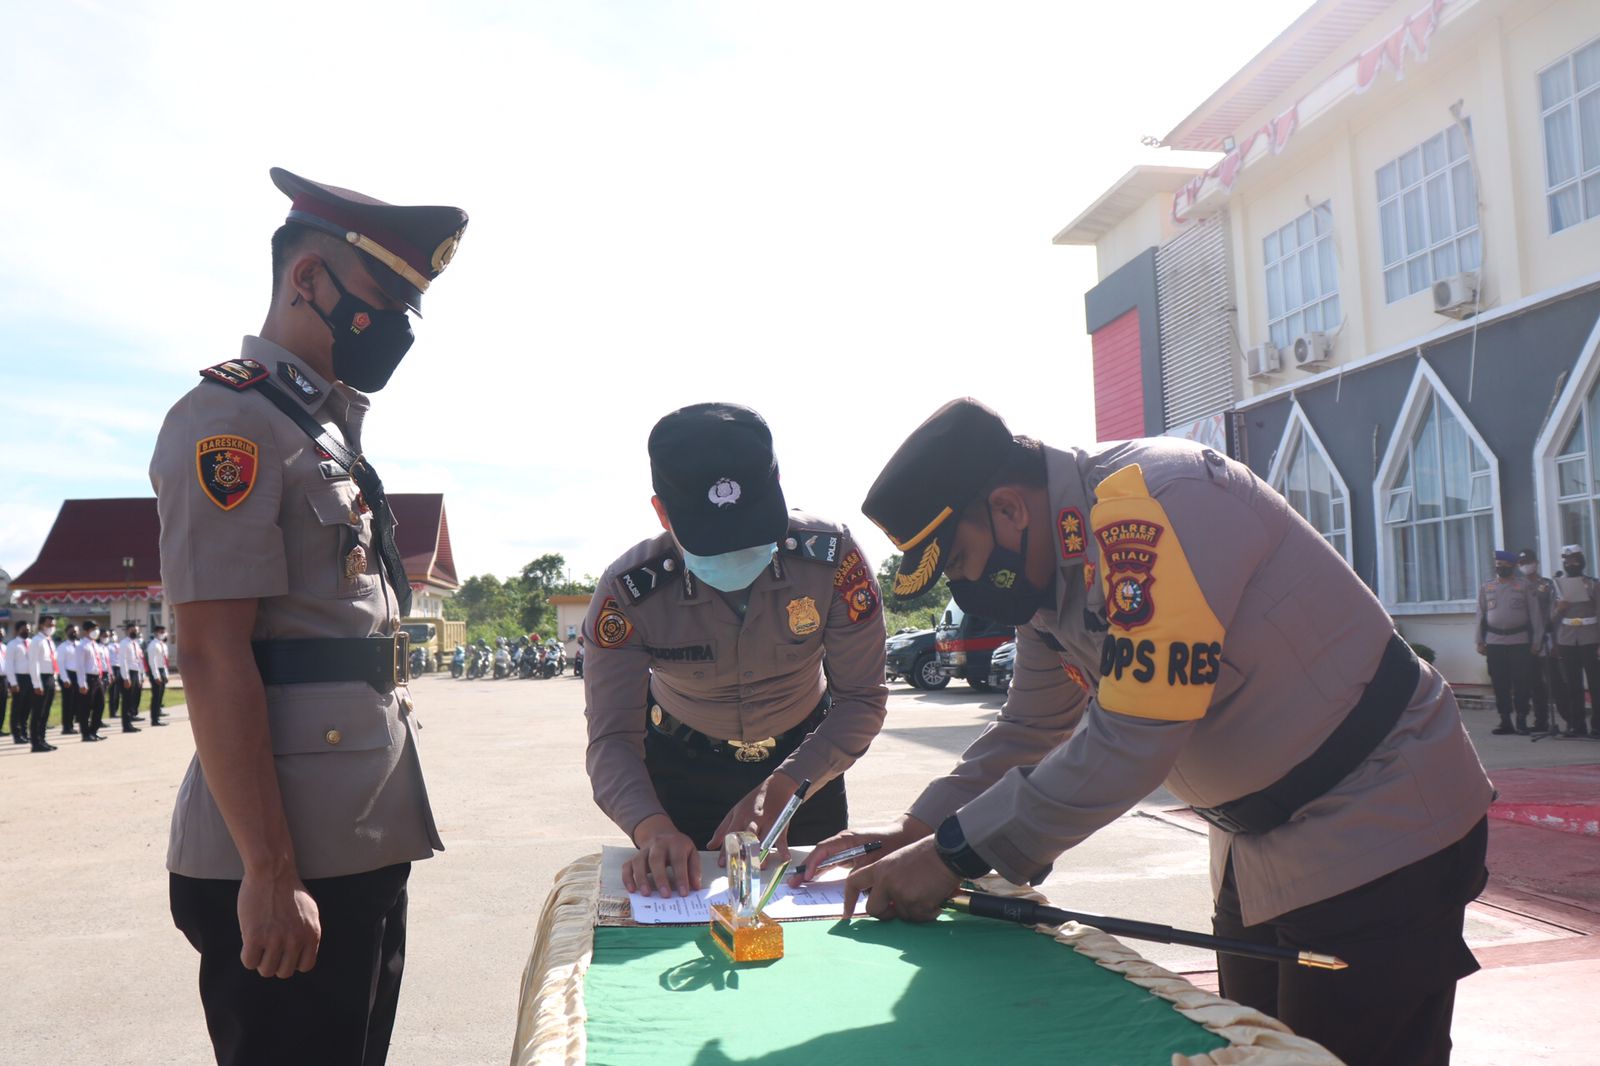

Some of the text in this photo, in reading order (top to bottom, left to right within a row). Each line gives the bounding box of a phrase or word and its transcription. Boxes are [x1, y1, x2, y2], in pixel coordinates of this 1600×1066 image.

[202, 438, 254, 454] BARESKRIM
[1101, 523, 1157, 540] POLRES
[826, 537, 838, 562] POLISI
[1112, 552, 1150, 562] RIAU
[623, 574, 640, 599] POLISI
[1168, 641, 1222, 686] RES
